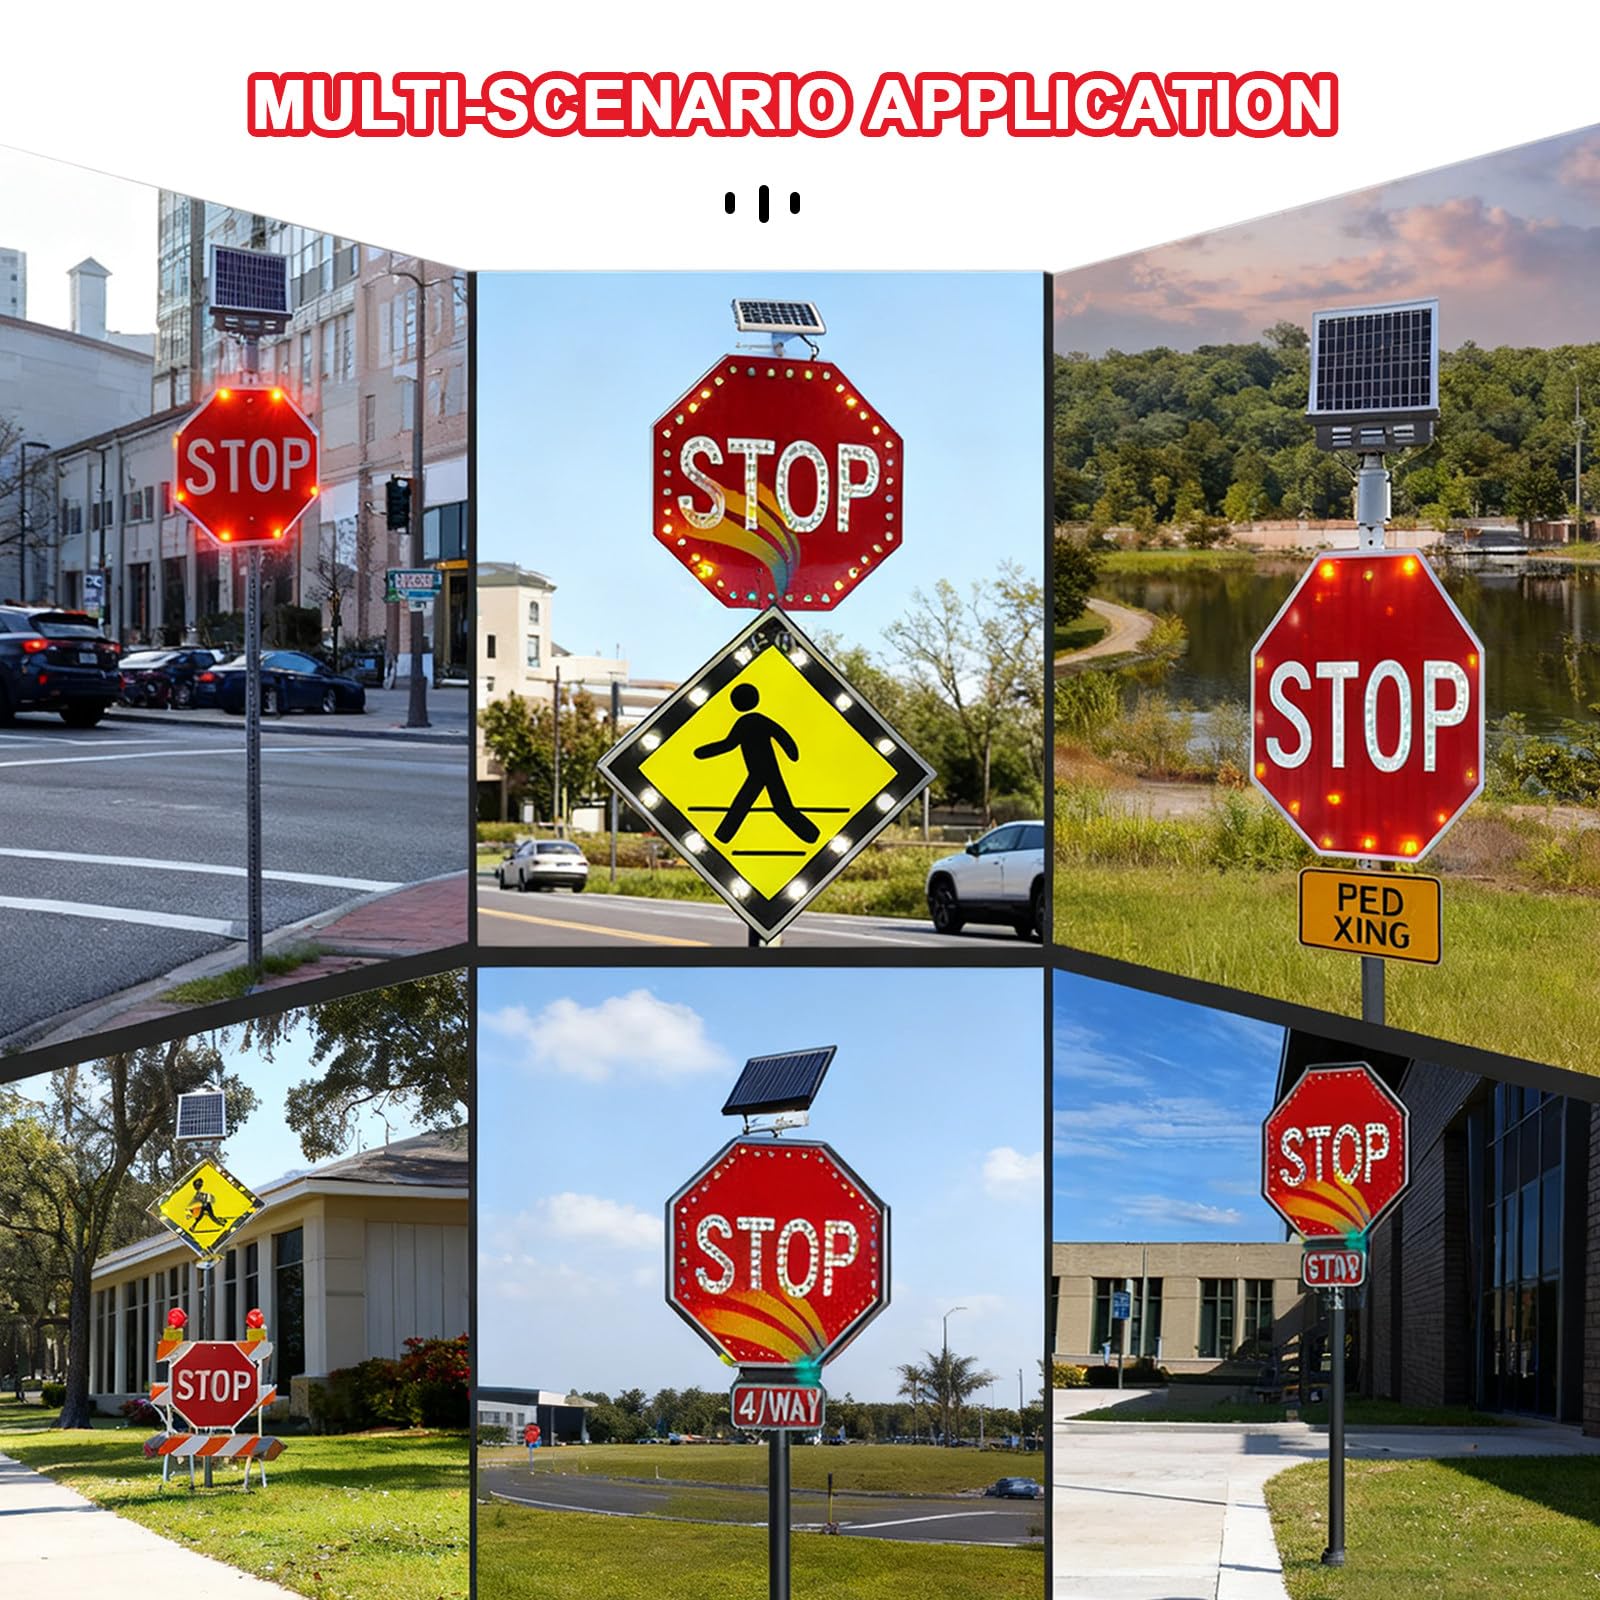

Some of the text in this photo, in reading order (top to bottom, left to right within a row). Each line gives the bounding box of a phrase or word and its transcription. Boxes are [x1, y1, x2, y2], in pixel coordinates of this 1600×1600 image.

[185, 437, 311, 495] STOP
[678, 436, 880, 532] STOP
[1266, 659, 1470, 772] STOP
[1338, 882, 1404, 916] PED
[1333, 916, 1410, 949] XING
[1280, 1123, 1389, 1186] STOP
[695, 1214, 858, 1297] STOP
[177, 1369, 251, 1402] STOP
